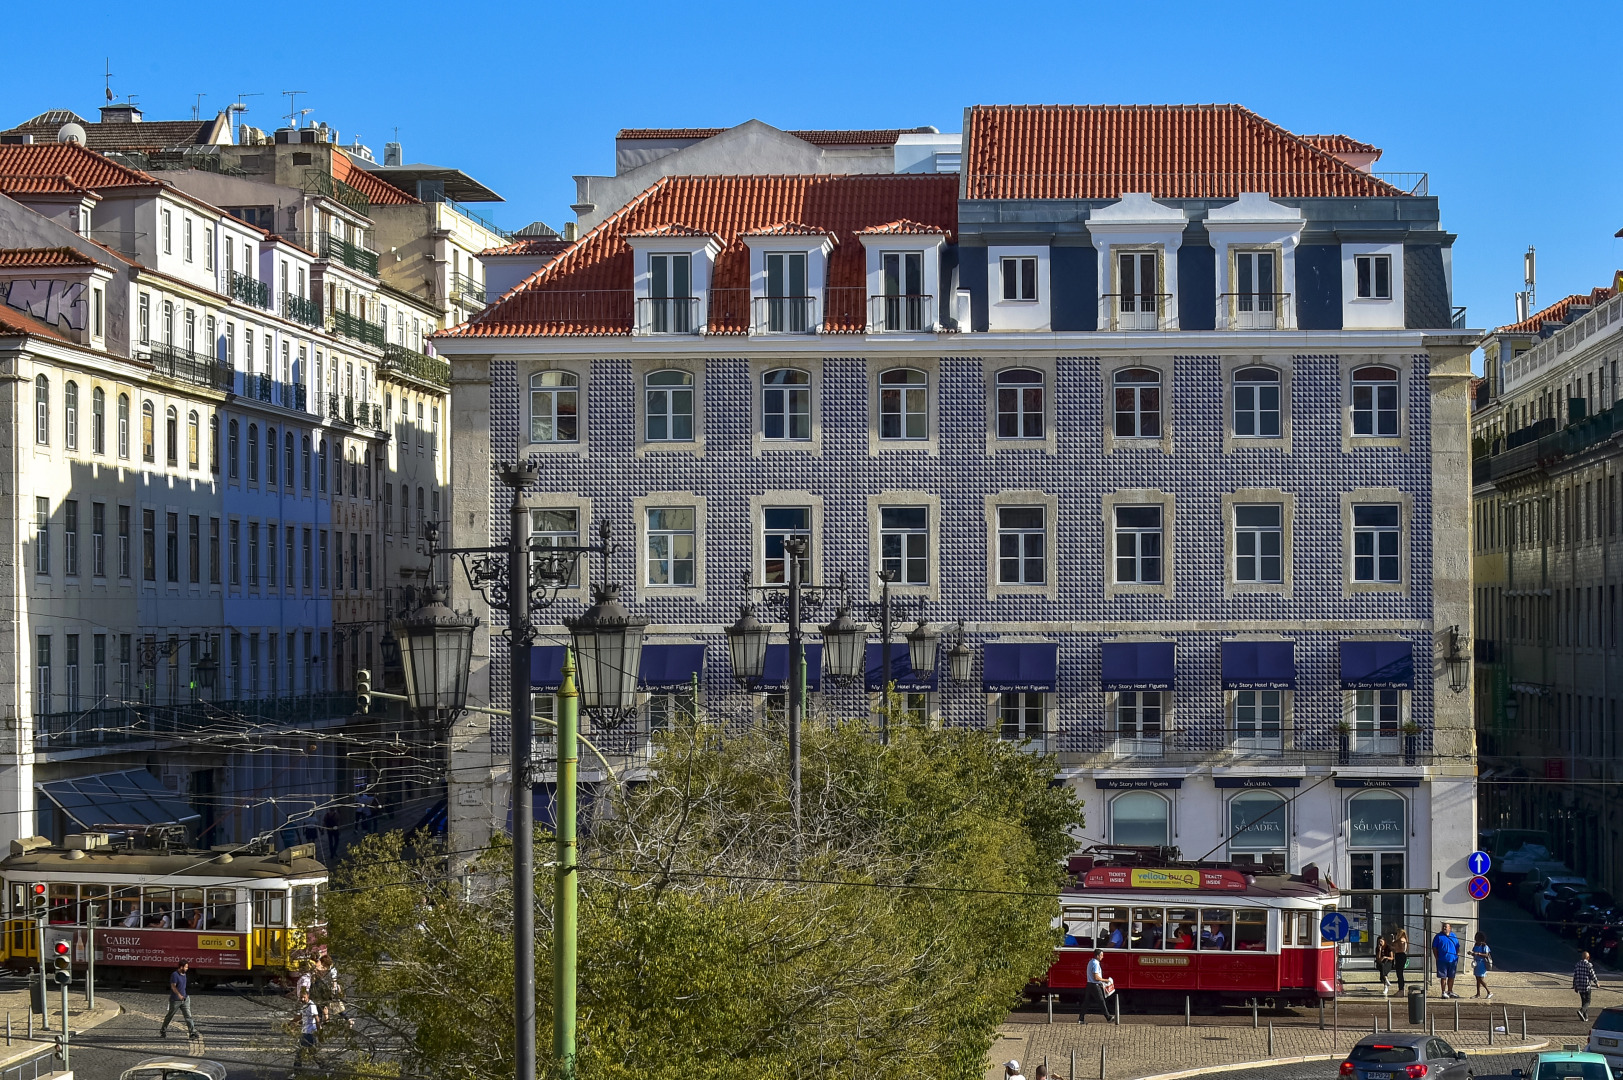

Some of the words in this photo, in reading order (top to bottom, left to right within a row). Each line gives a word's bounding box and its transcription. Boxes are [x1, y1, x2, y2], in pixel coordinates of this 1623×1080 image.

[1138, 872, 1168, 880] yellow
[106, 936, 141, 946] CABRIZ
[106, 952, 114, 960] O
[114, 953, 140, 961] melhor
[141, 954, 162, 962] ainda
[163, 955, 180, 963] está
